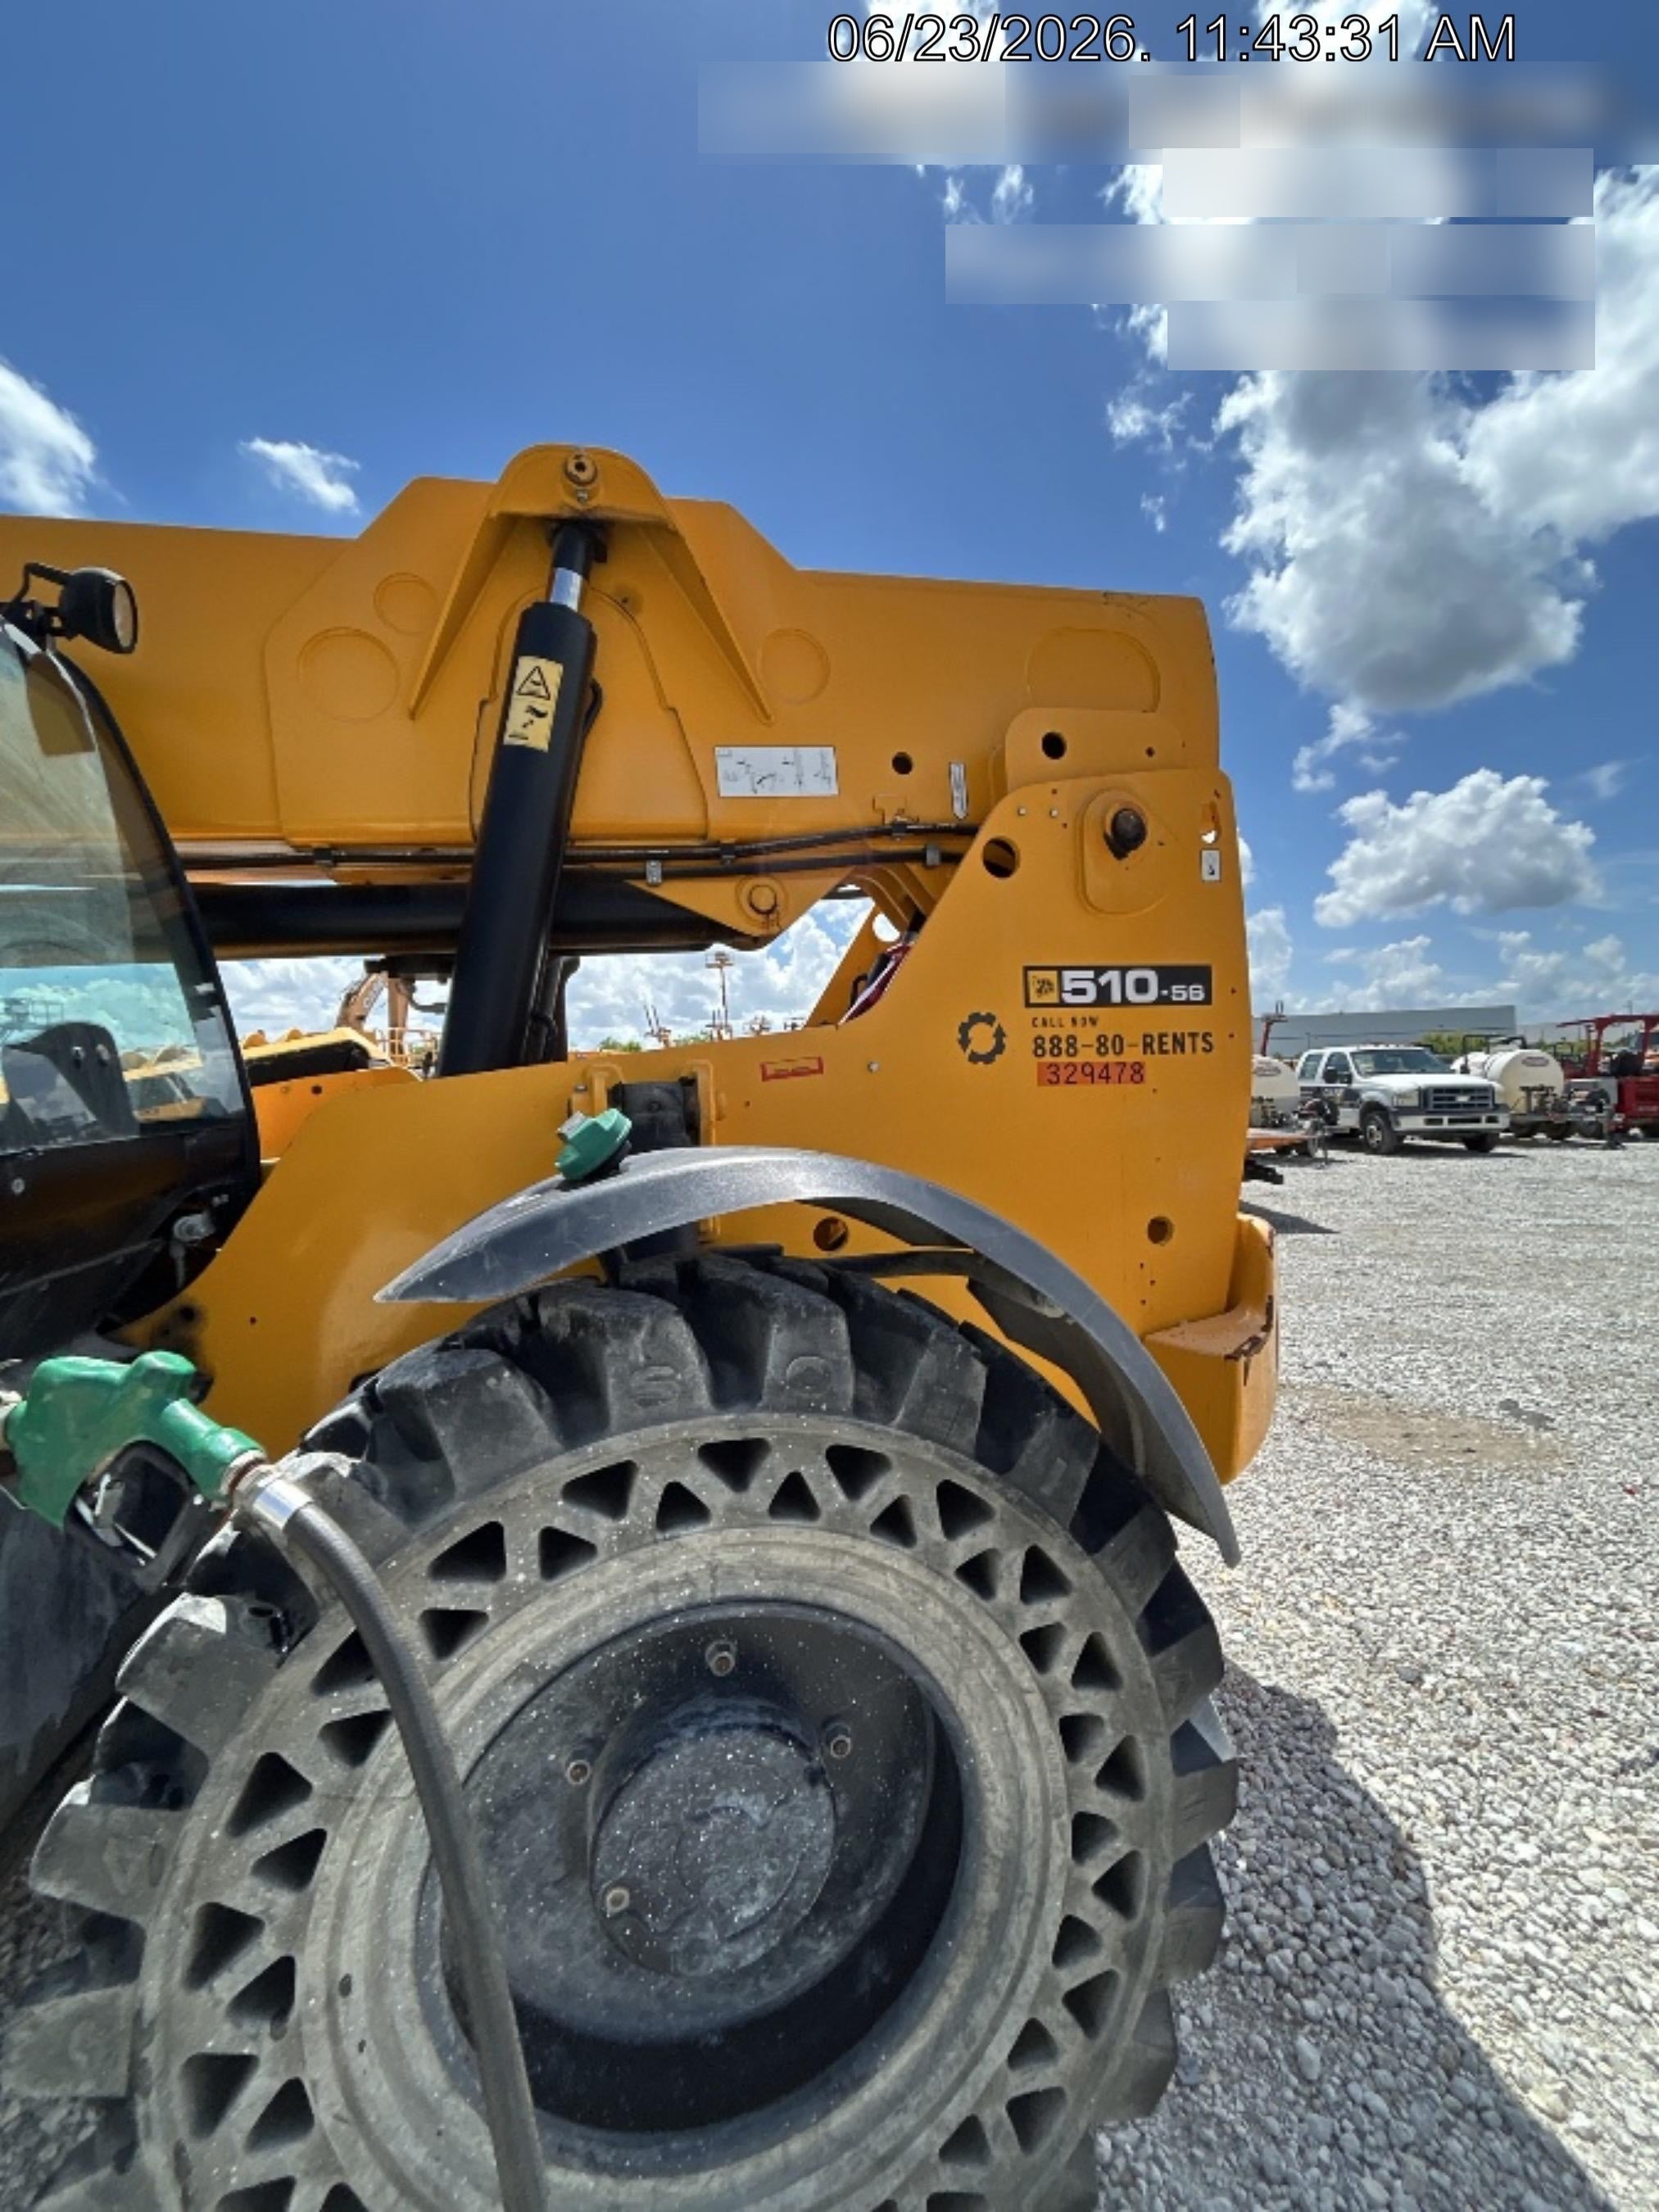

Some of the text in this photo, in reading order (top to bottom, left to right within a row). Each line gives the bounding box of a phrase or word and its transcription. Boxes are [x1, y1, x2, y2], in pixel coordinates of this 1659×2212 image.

[1031, 1016, 1099, 1028] CALL NOW
[1033, 1031, 1214, 1058] 888-80-RENTS
[1046, 1062, 1145, 1085] 329478
